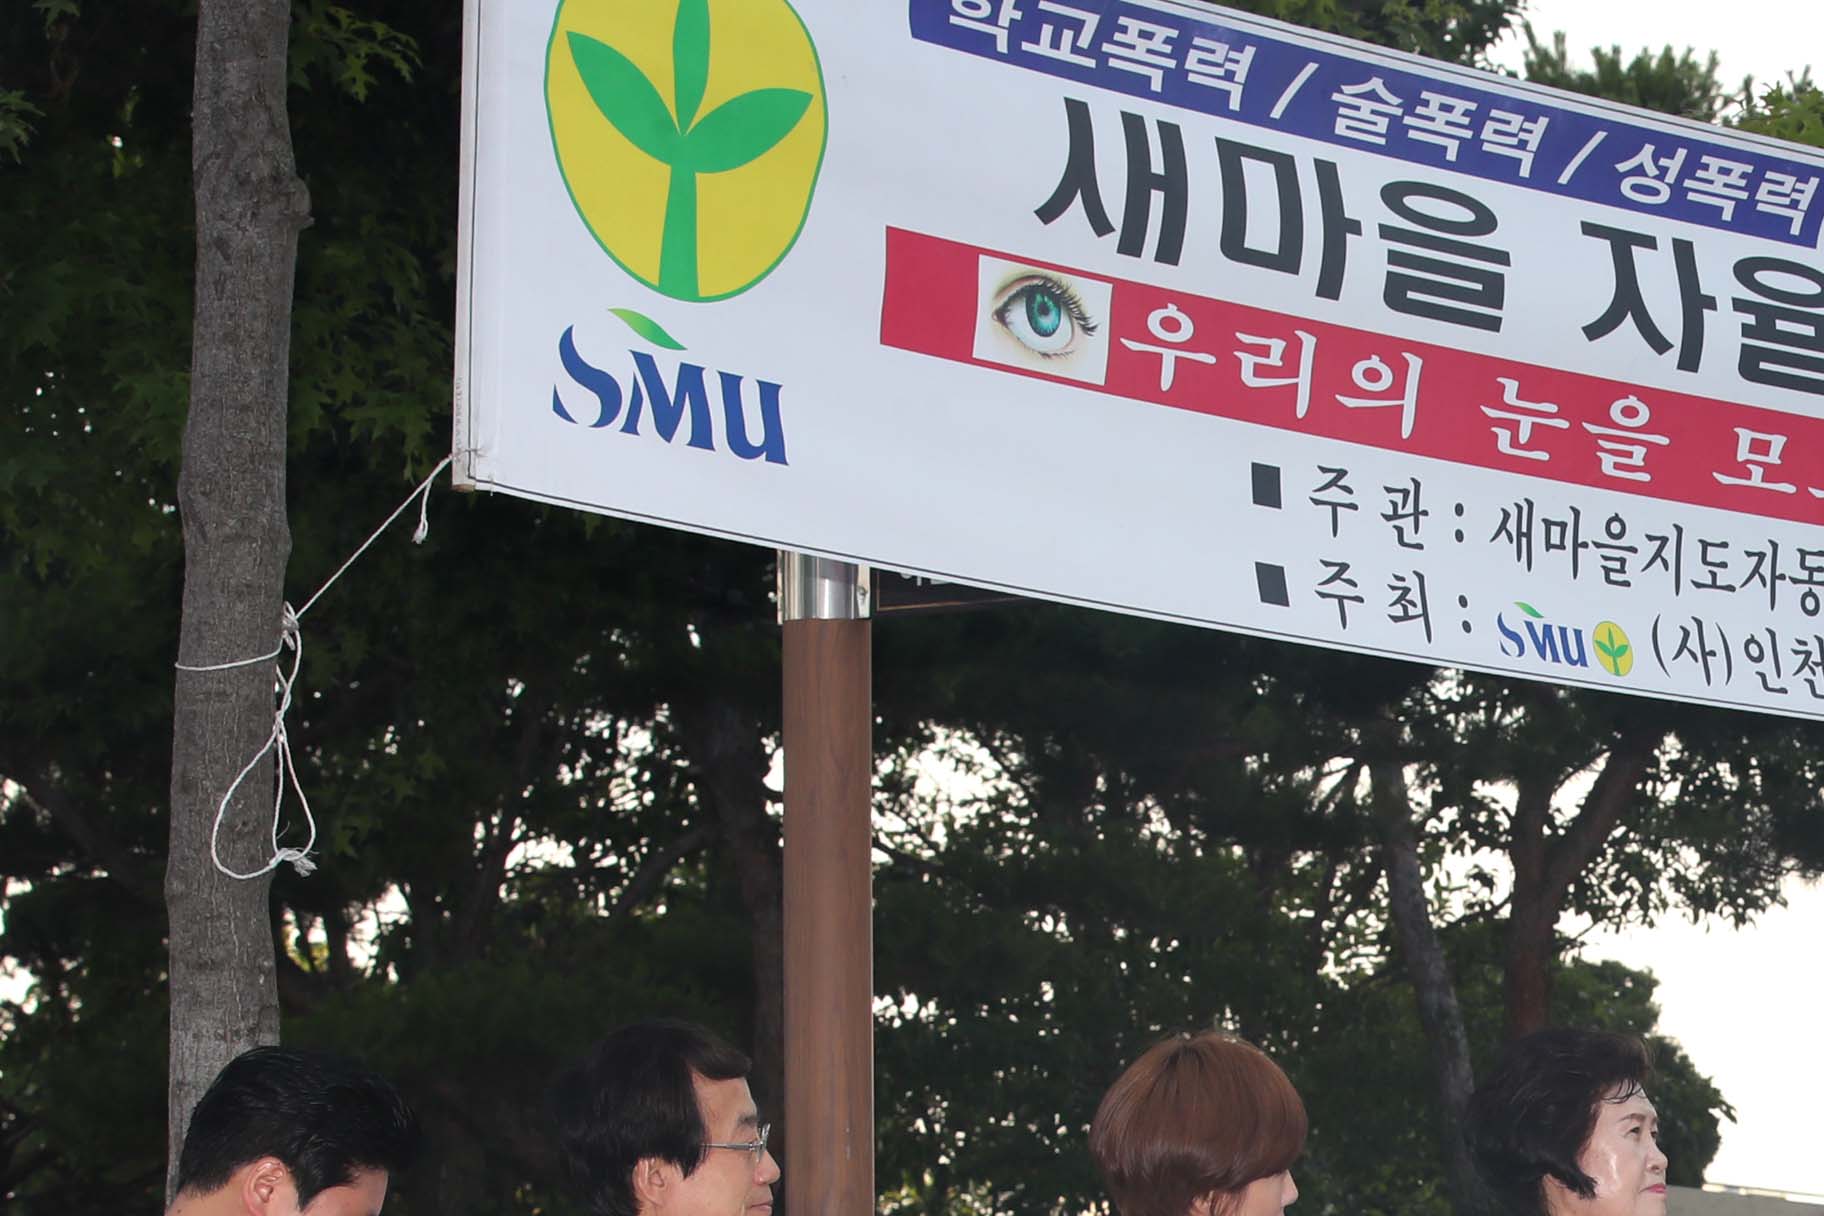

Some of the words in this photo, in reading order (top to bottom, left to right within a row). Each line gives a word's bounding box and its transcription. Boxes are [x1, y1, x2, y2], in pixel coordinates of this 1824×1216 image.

[950, 0, 1256, 111] 학교폭력
[1332, 77, 1549, 177] 술폭력
[1615, 144, 1819, 235] 성폭력
[1034, 97, 1510, 334] 새마을
[553, 326, 786, 464] SMU
[1118, 303, 1423, 439] 우리의
[1480, 378, 1669, 481] 눈을
